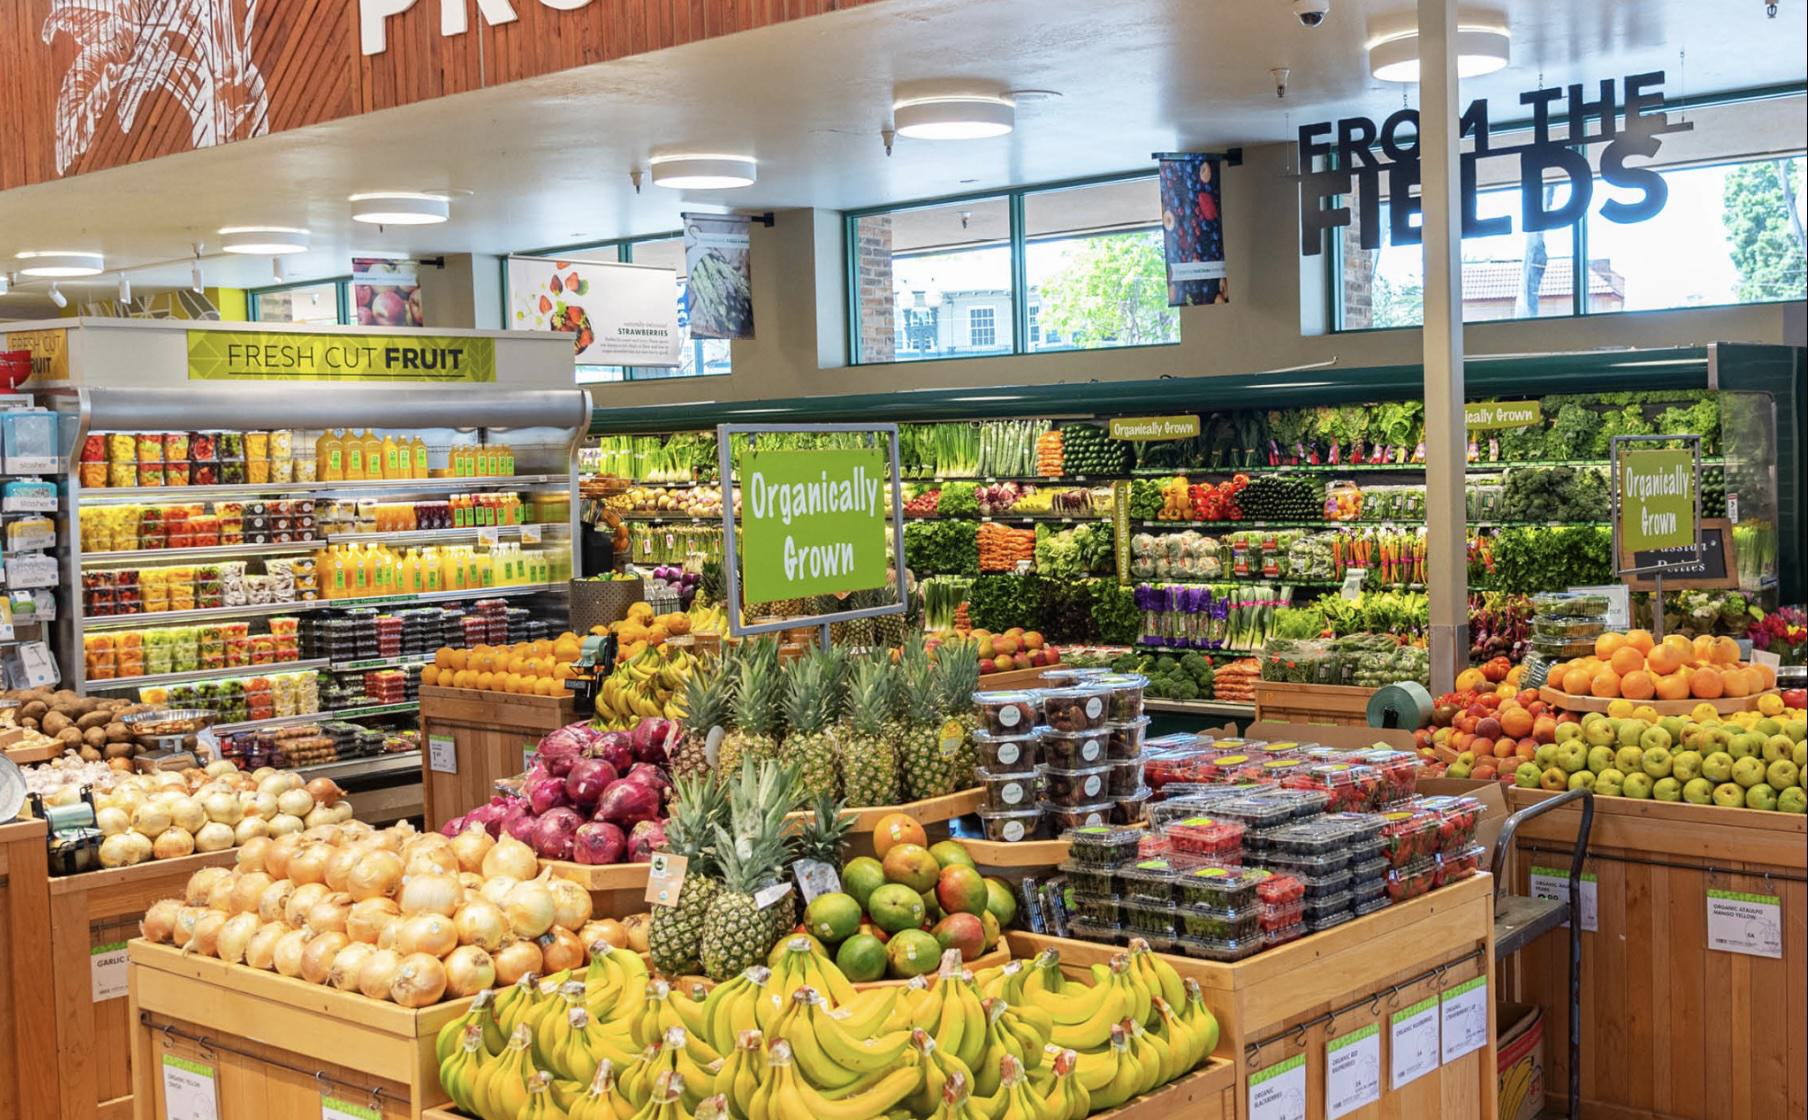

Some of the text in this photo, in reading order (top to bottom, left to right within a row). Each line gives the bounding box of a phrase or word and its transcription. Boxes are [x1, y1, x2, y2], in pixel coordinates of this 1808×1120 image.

[1299, 71, 1667, 175] FROM THE
[1301, 130, 1669, 255] FIELDS
[42, 335, 61, 352] CUT
[618, 327, 668, 337] STRAWBERRIES
[228, 344, 464, 370] FRESH CUT FRUIT
[1114, 420, 1194, 438] Organically Grown
[1464, 407, 1533, 425] ically Grown
[751, 466, 878, 526] Organically
[1626, 464, 1689, 502] Organically
[1119, 487, 1127, 543] Organically
[1641, 506, 1677, 536] Grown
[783, 535, 855, 582] Grown
[96, 955, 126, 968] GARLIC
[1254, 1086, 1275, 1100] ORGANIC
